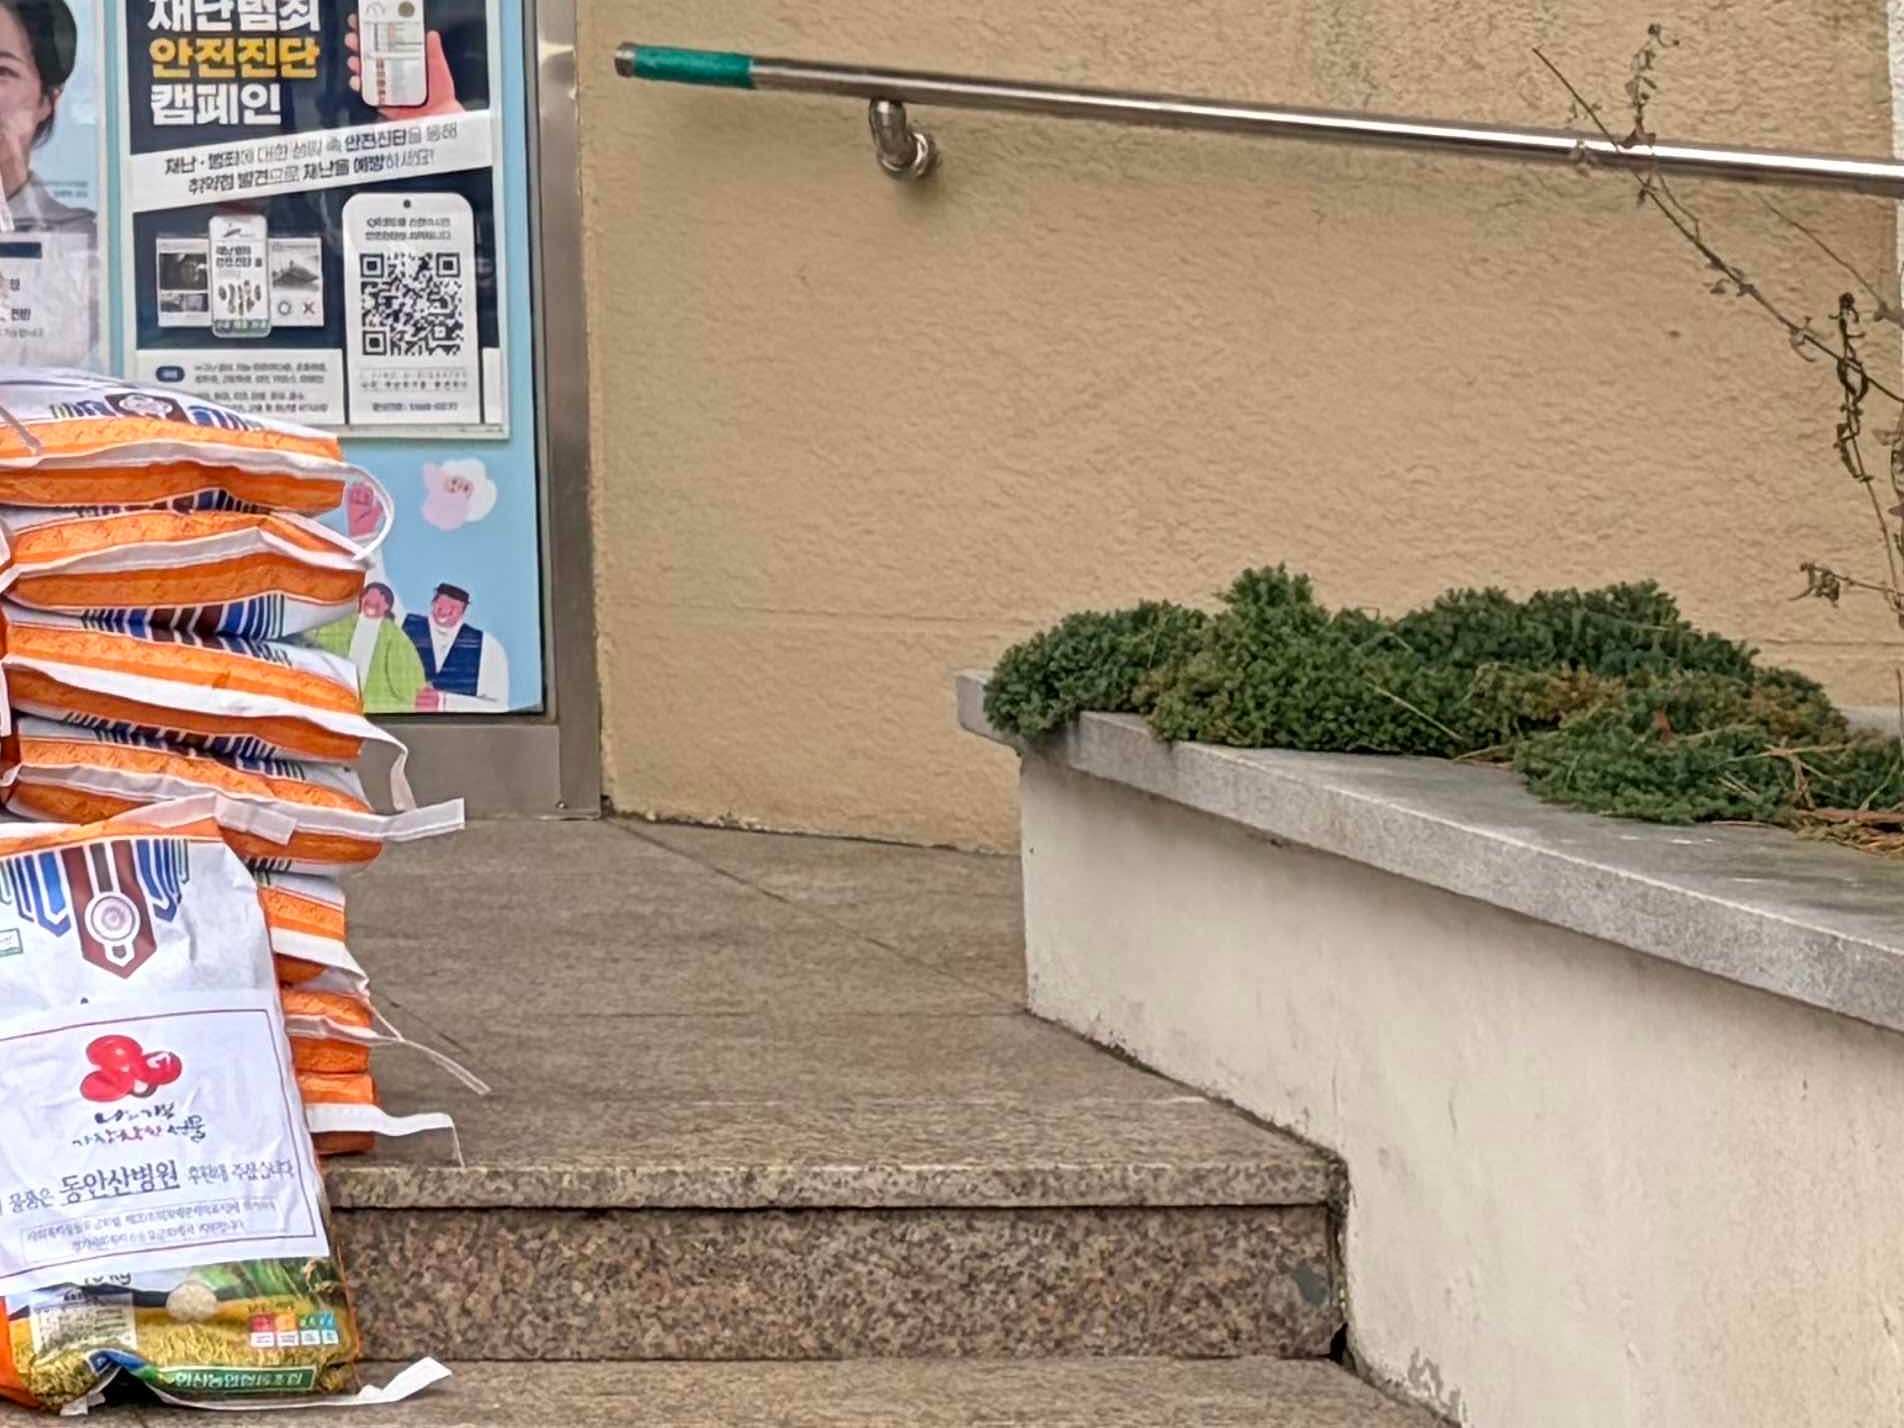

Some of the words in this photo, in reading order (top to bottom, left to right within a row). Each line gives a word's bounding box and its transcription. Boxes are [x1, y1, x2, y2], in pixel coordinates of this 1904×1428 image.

[149, 37, 321, 79] 안전진단
[150, 83, 281, 126] 캠페인
[60, 1158, 181, 1206] 동안산병원
